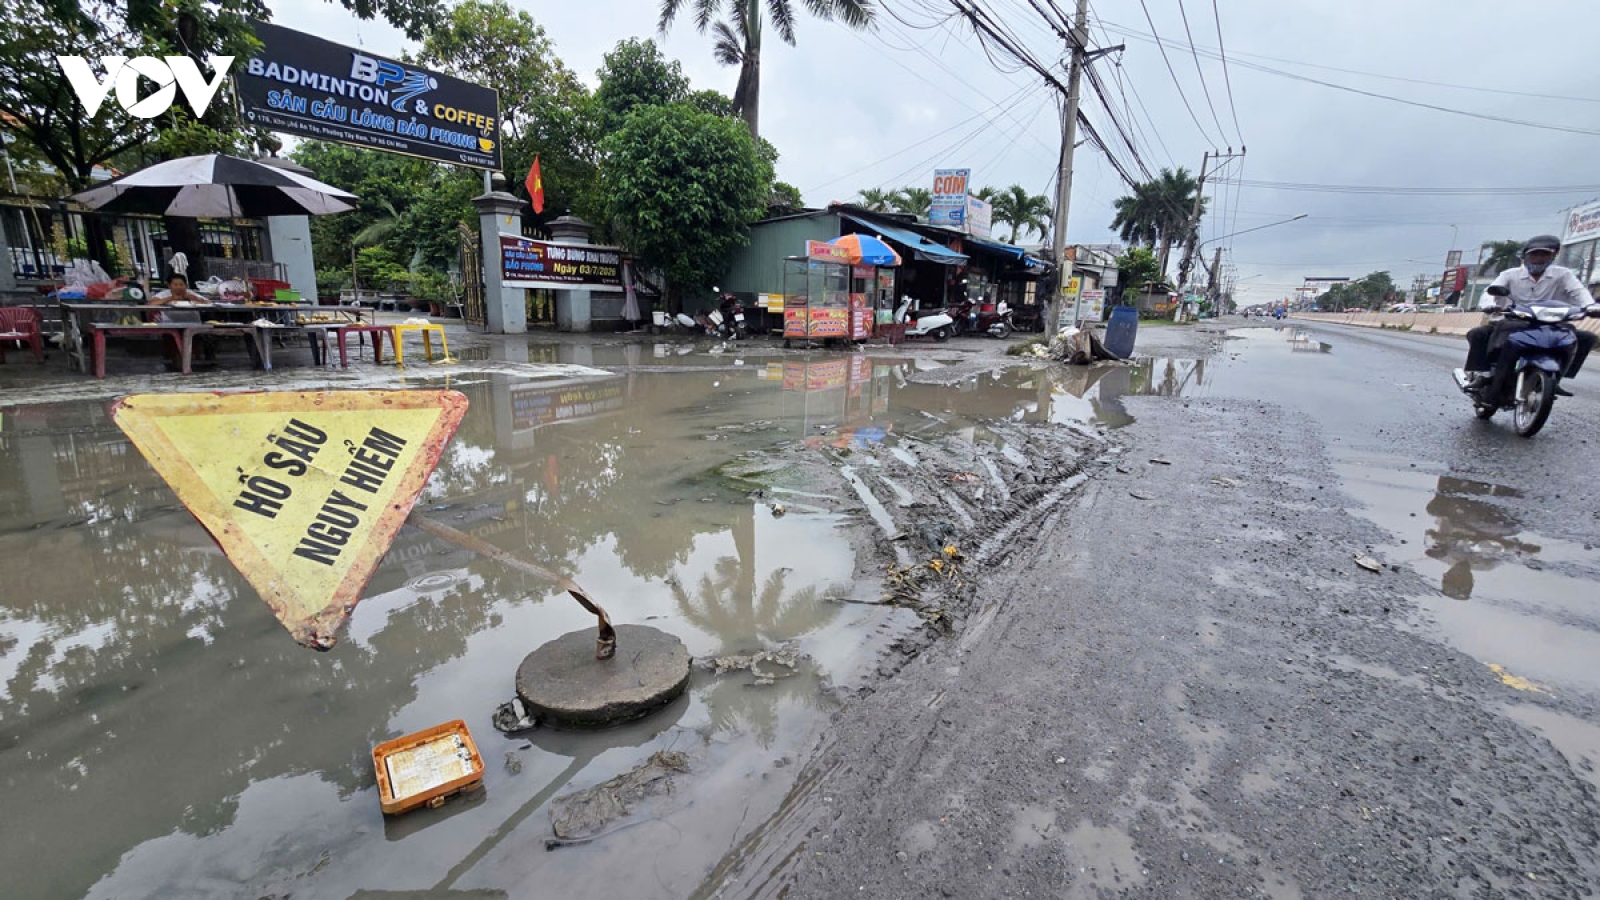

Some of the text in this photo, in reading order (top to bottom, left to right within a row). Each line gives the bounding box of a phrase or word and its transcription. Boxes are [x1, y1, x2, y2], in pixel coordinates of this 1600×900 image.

[248, 58, 495, 131] BADMINTON & COFFEE
[267, 88, 477, 149] SÂN CẦU LÔNG BẢO PHONG
[934, 175, 966, 194] CƠM
[553, 263, 577, 276] Ngày
[233, 418, 328, 519] HỐ SÂU
[293, 427, 408, 566] NGUY HIỂM
